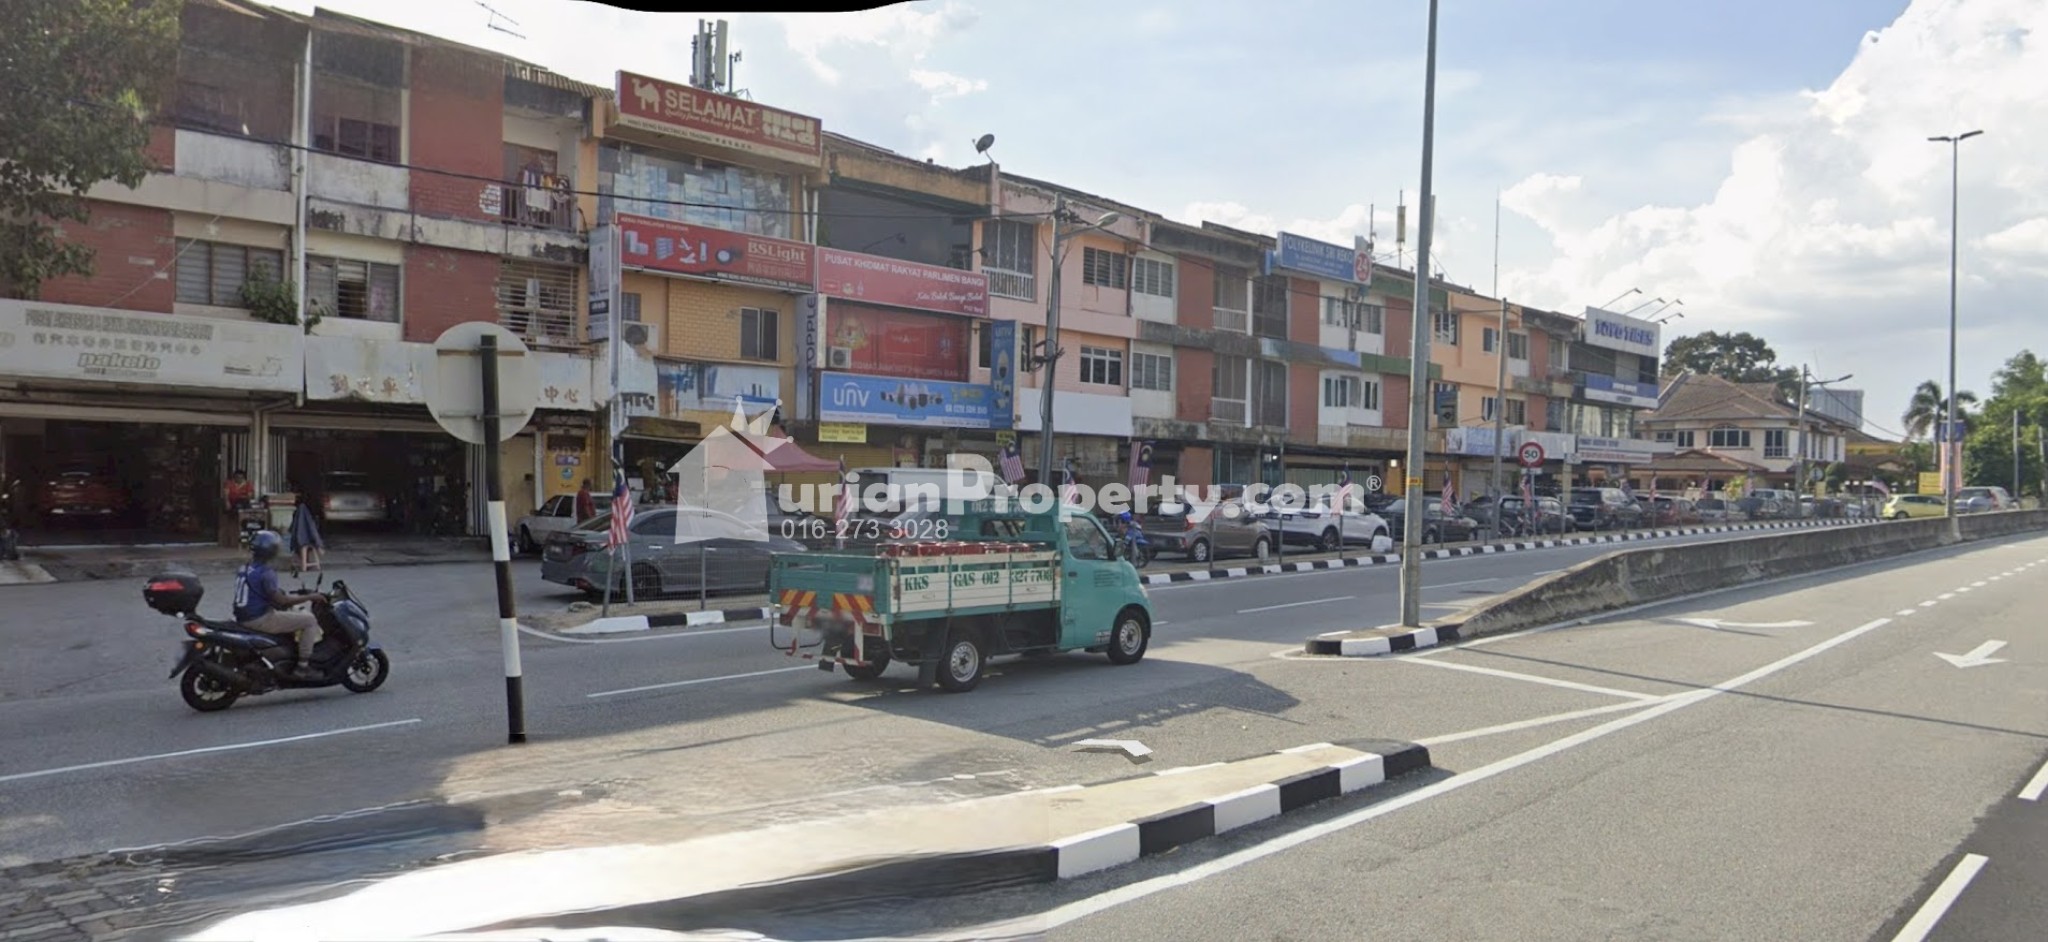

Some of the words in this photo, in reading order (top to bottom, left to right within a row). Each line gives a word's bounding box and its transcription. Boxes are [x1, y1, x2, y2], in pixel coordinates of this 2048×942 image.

[664, 88, 757, 125] SELAMAT
[747, 241, 806, 262] BSLight
[825, 253, 852, 266] PUSAT
[854, 258, 890, 272] KHIDMAT
[891, 264, 922, 278] RAKYAT
[923, 270, 960, 283] PARLIMEN
[961, 275, 984, 287] BANGI
[1594, 319, 1623, 340] TOYO
[1524, 450, 1538, 459] 50
[904, 574, 929, 592] KKS
[953, 569, 976, 588] GAS
[982, 568, 999, 586] 012
